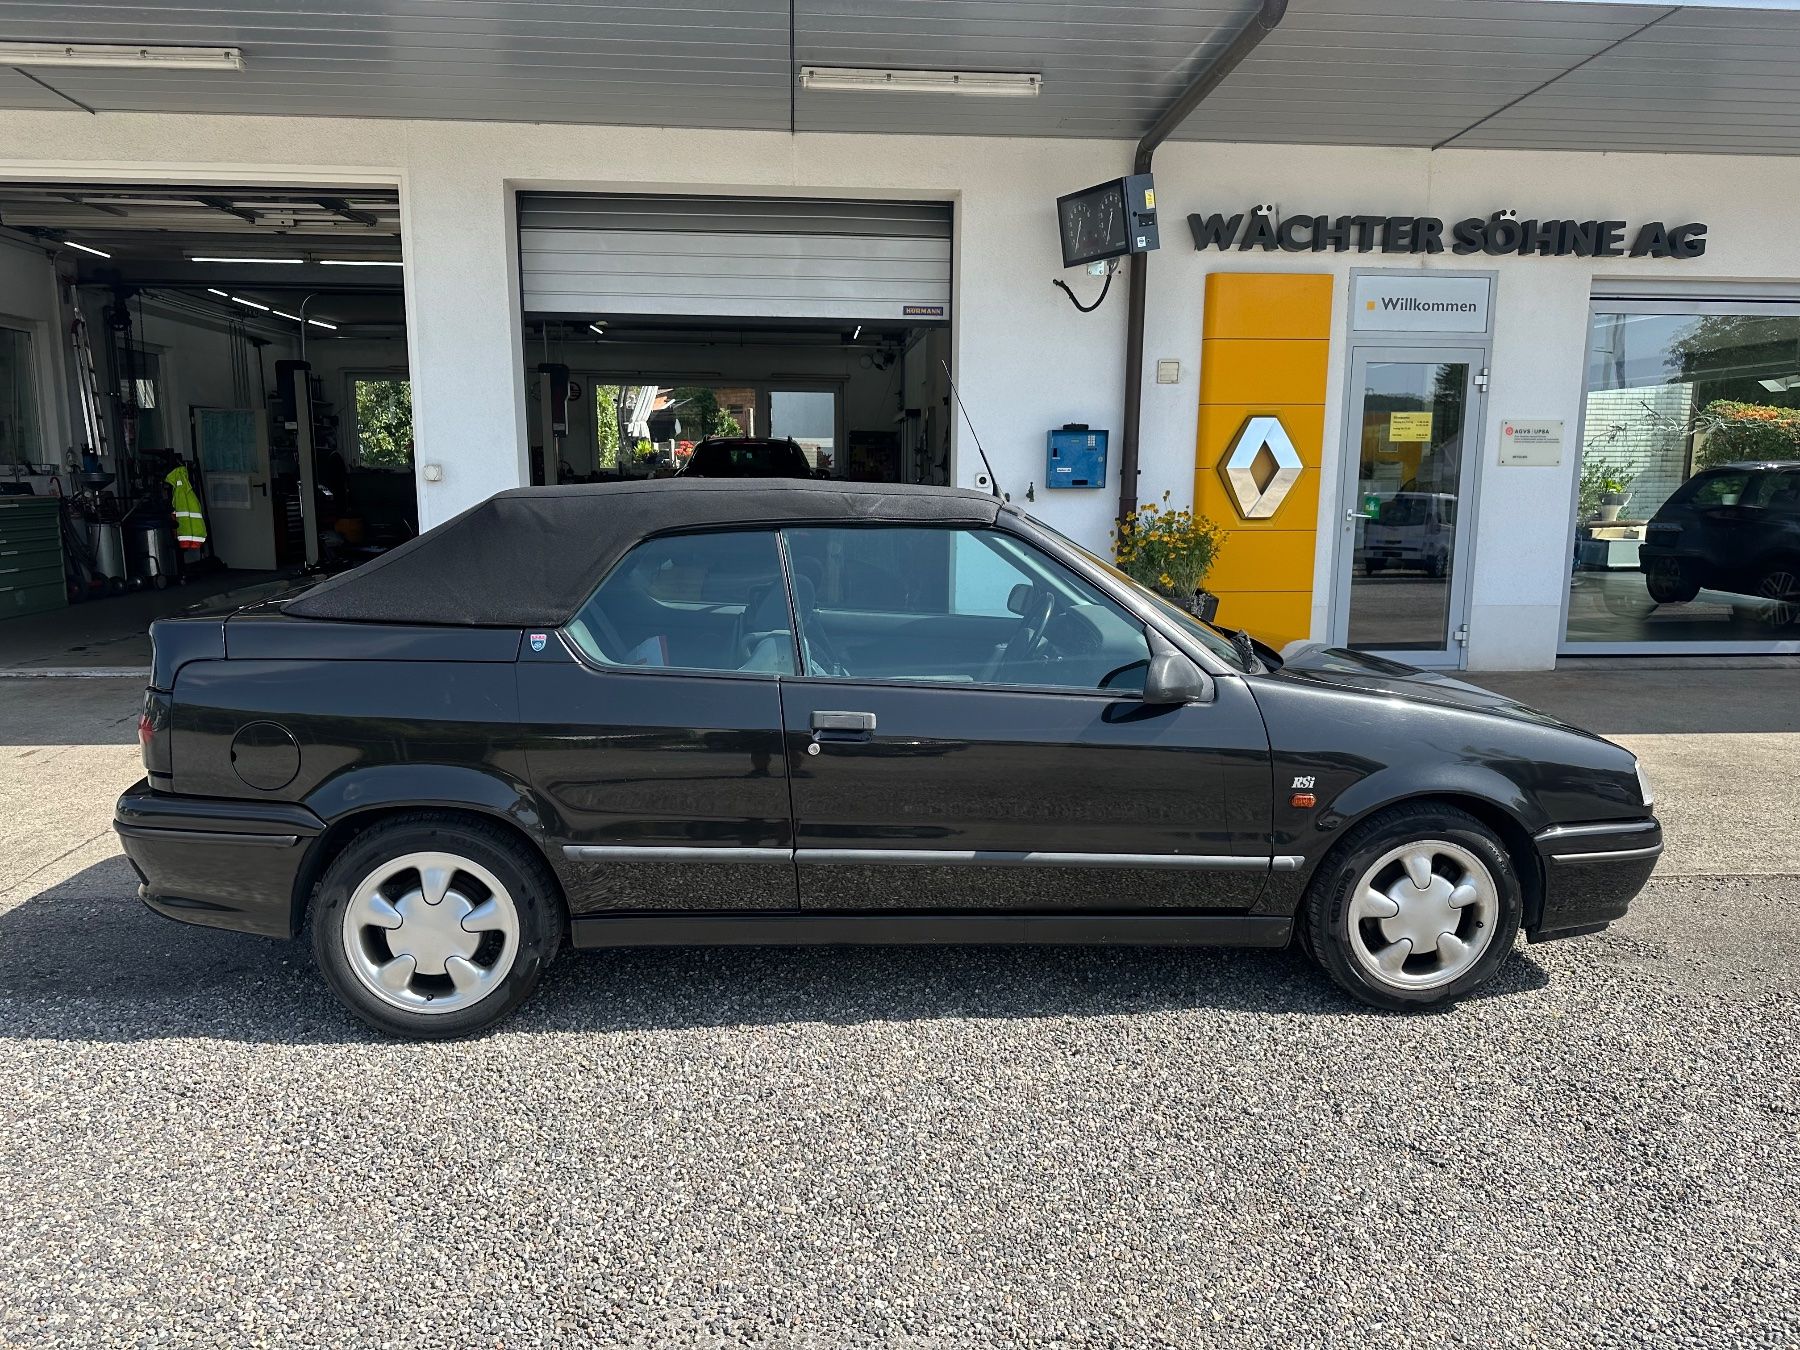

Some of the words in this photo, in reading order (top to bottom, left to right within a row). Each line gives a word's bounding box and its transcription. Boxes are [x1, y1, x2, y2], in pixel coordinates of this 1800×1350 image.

[1187, 204, 1444, 253] WÄCHTER
[1452, 209, 1626, 257] SÖHNE
[1628, 221, 1708, 259] AG
[1381, 297, 1477, 312] Willkommen
[1291, 776, 1316, 789] RSi
